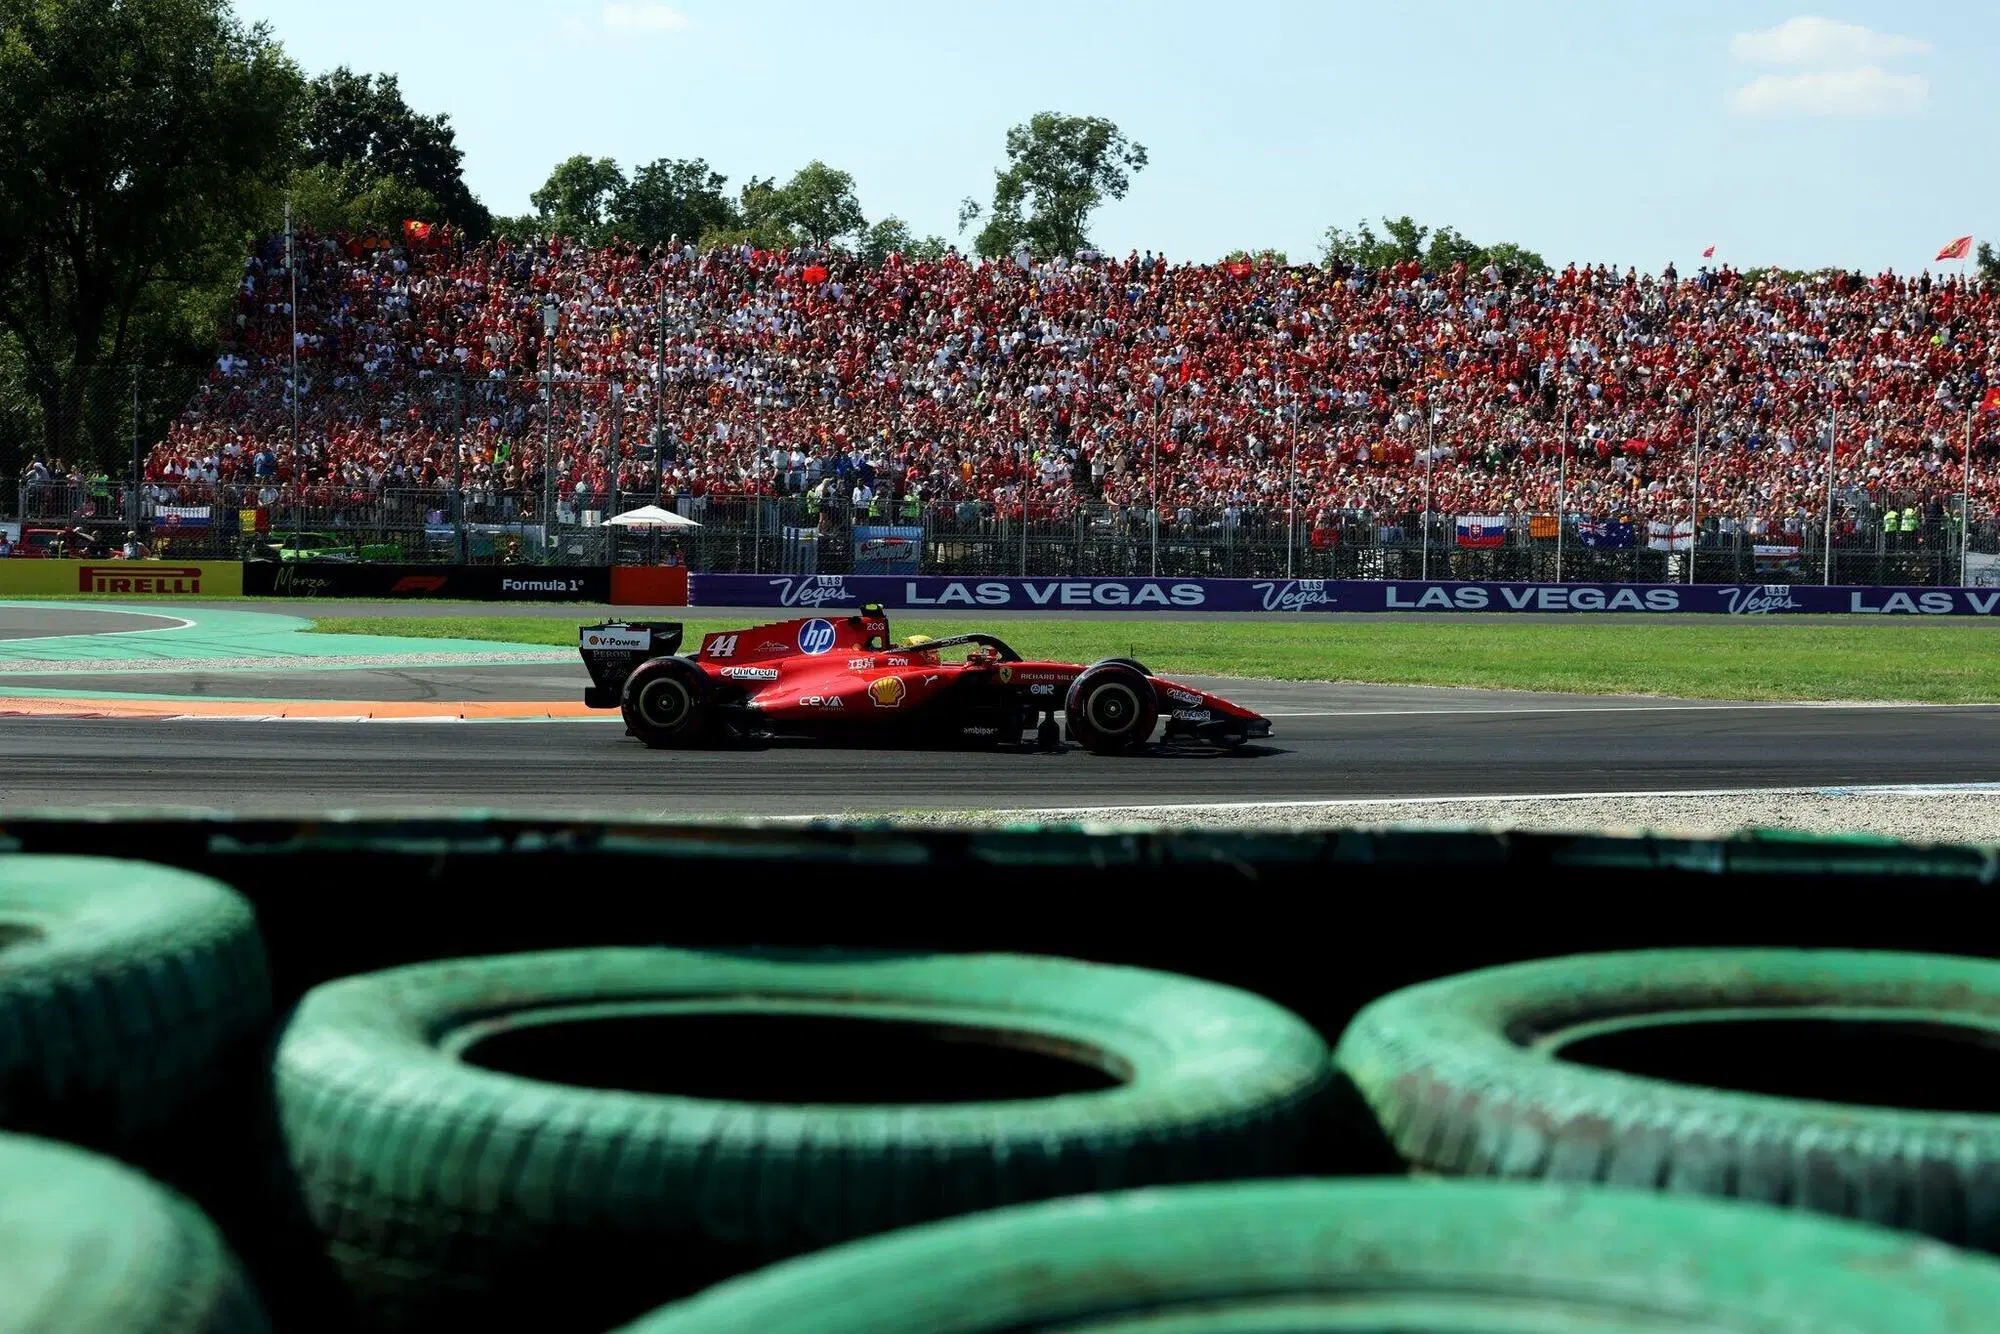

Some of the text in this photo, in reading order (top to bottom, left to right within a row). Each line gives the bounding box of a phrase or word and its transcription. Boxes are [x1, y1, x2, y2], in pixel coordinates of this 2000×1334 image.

[79, 566, 202, 593] PIRELLI
[502, 578, 566, 591] Formula
[819, 576, 841, 586] LAS
[1300, 580, 1323, 590] LAS
[1766, 585, 1788, 595] LAS
[769, 576, 856, 608] Vegas
[906, 582, 1205, 606] LAS VEGAS
[1252, 580, 1338, 611] Vegas
[1386, 586, 1680, 610] LAS VEGAS
[1718, 585, 1802, 614] Vegas
[1851, 591, 1954, 614] LAS
[600, 637, 641, 647] V-Power
[706, 635, 739, 657] 44
[803, 620, 831, 654] hp
[593, 650, 632, 658] PERONI
[887, 657, 909, 666] ZYN
[732, 667, 777, 677] UniCredit
